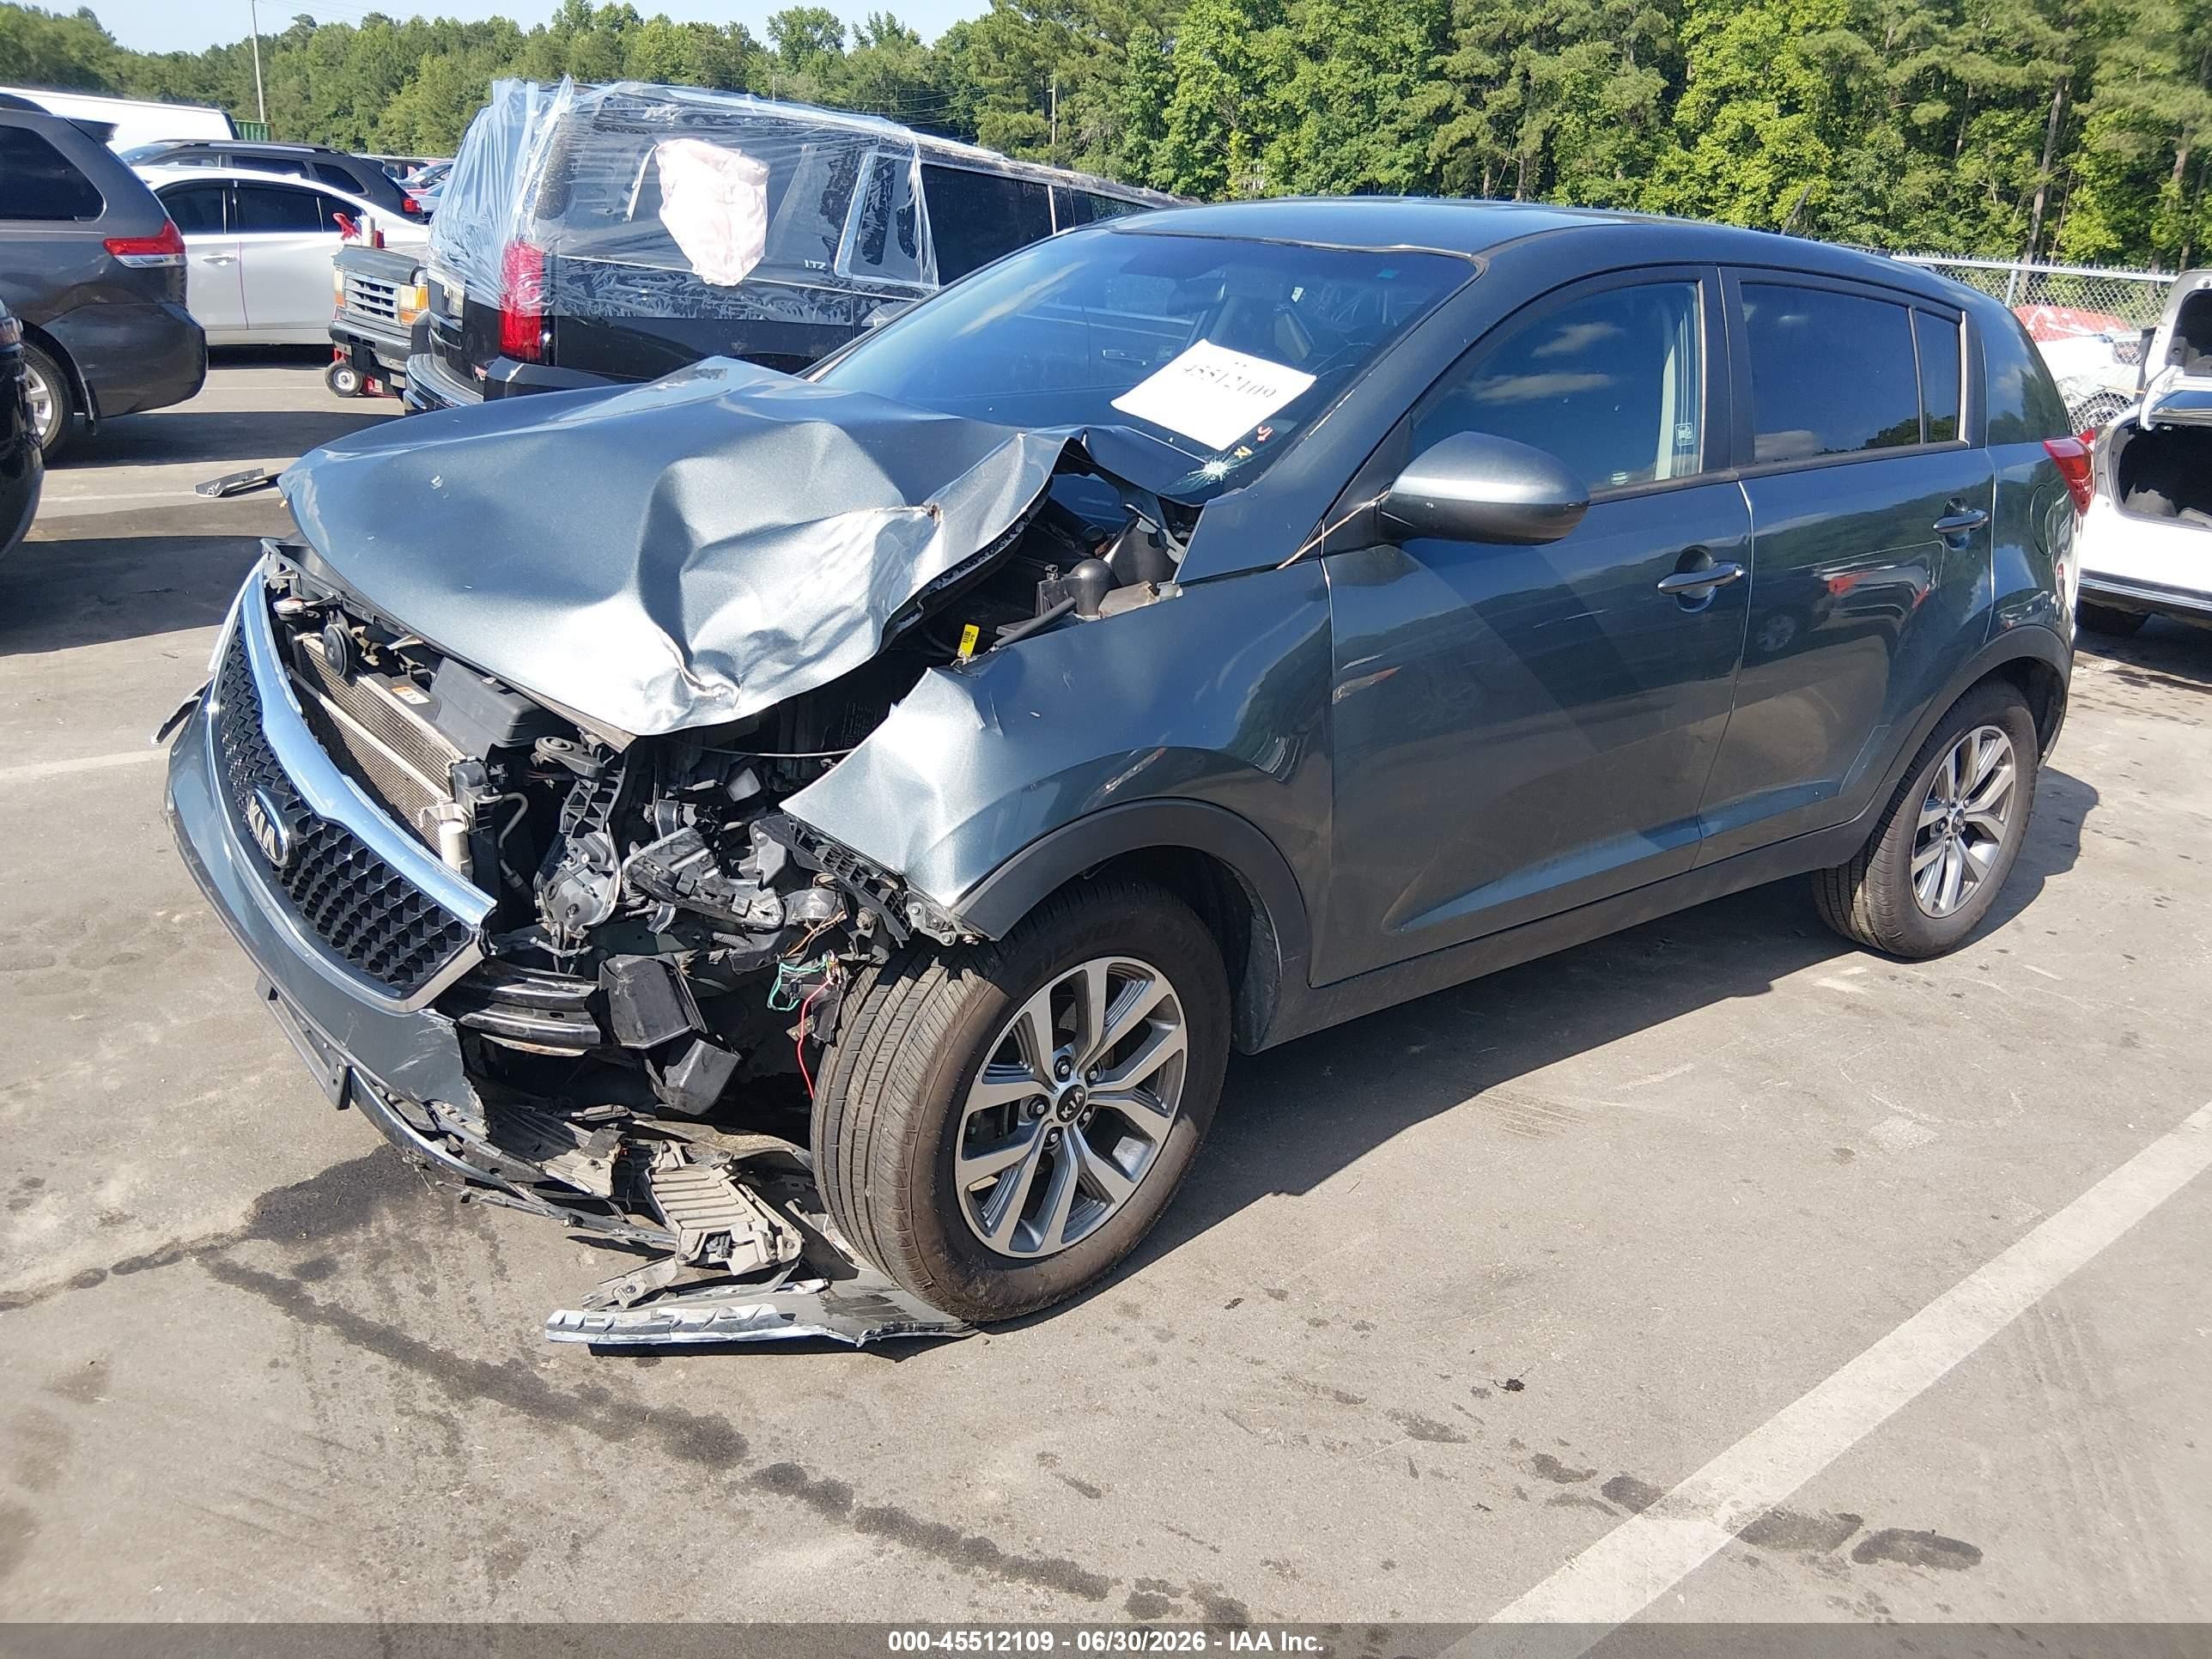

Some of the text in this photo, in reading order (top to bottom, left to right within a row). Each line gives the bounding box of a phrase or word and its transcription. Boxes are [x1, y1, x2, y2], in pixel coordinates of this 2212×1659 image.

[805, 259, 827, 270] LTZ
[247, 794, 277, 860] KIA
[1060, 1091, 1084, 1119] KIA
